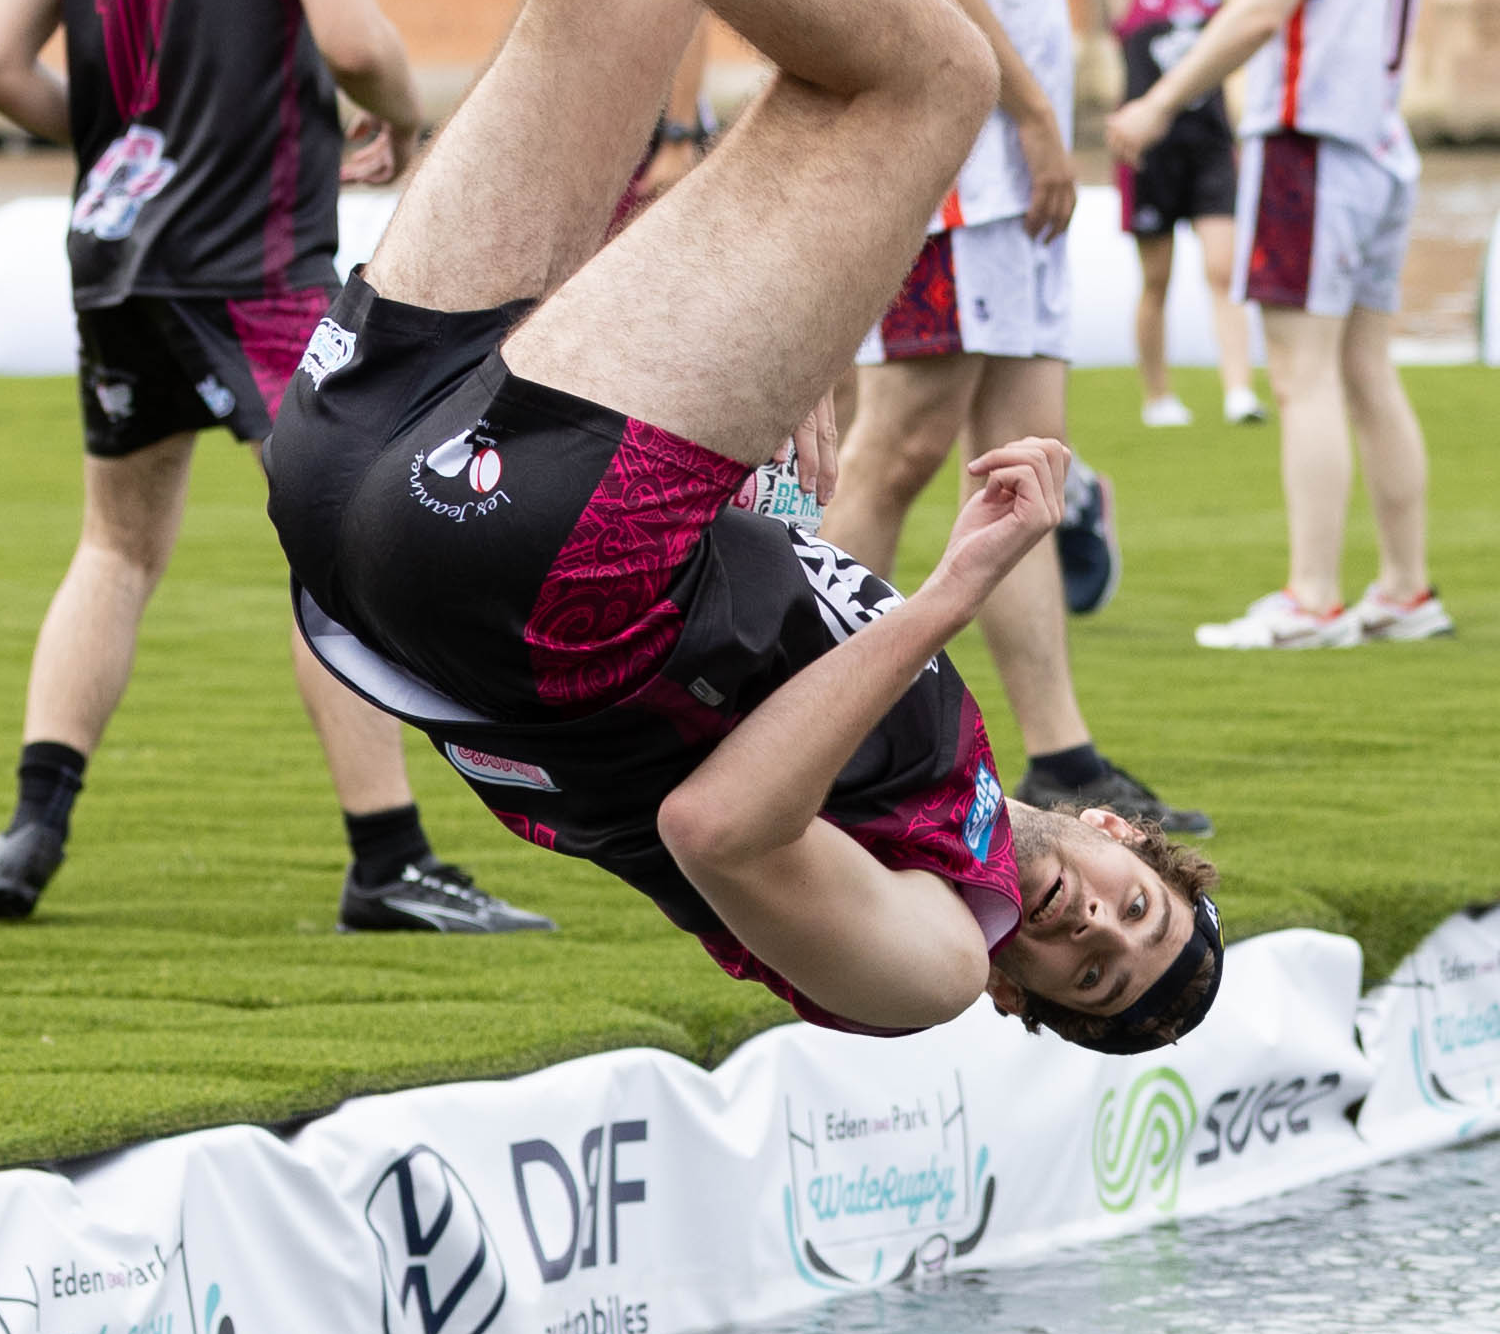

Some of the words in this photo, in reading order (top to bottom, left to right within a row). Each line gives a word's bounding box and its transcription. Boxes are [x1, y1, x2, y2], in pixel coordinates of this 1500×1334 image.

[476, 490, 511, 517] Les
[826, 1109, 869, 1142] Eden
[892, 1098, 929, 1134] Park
[52, 1260, 105, 1299] Eden
